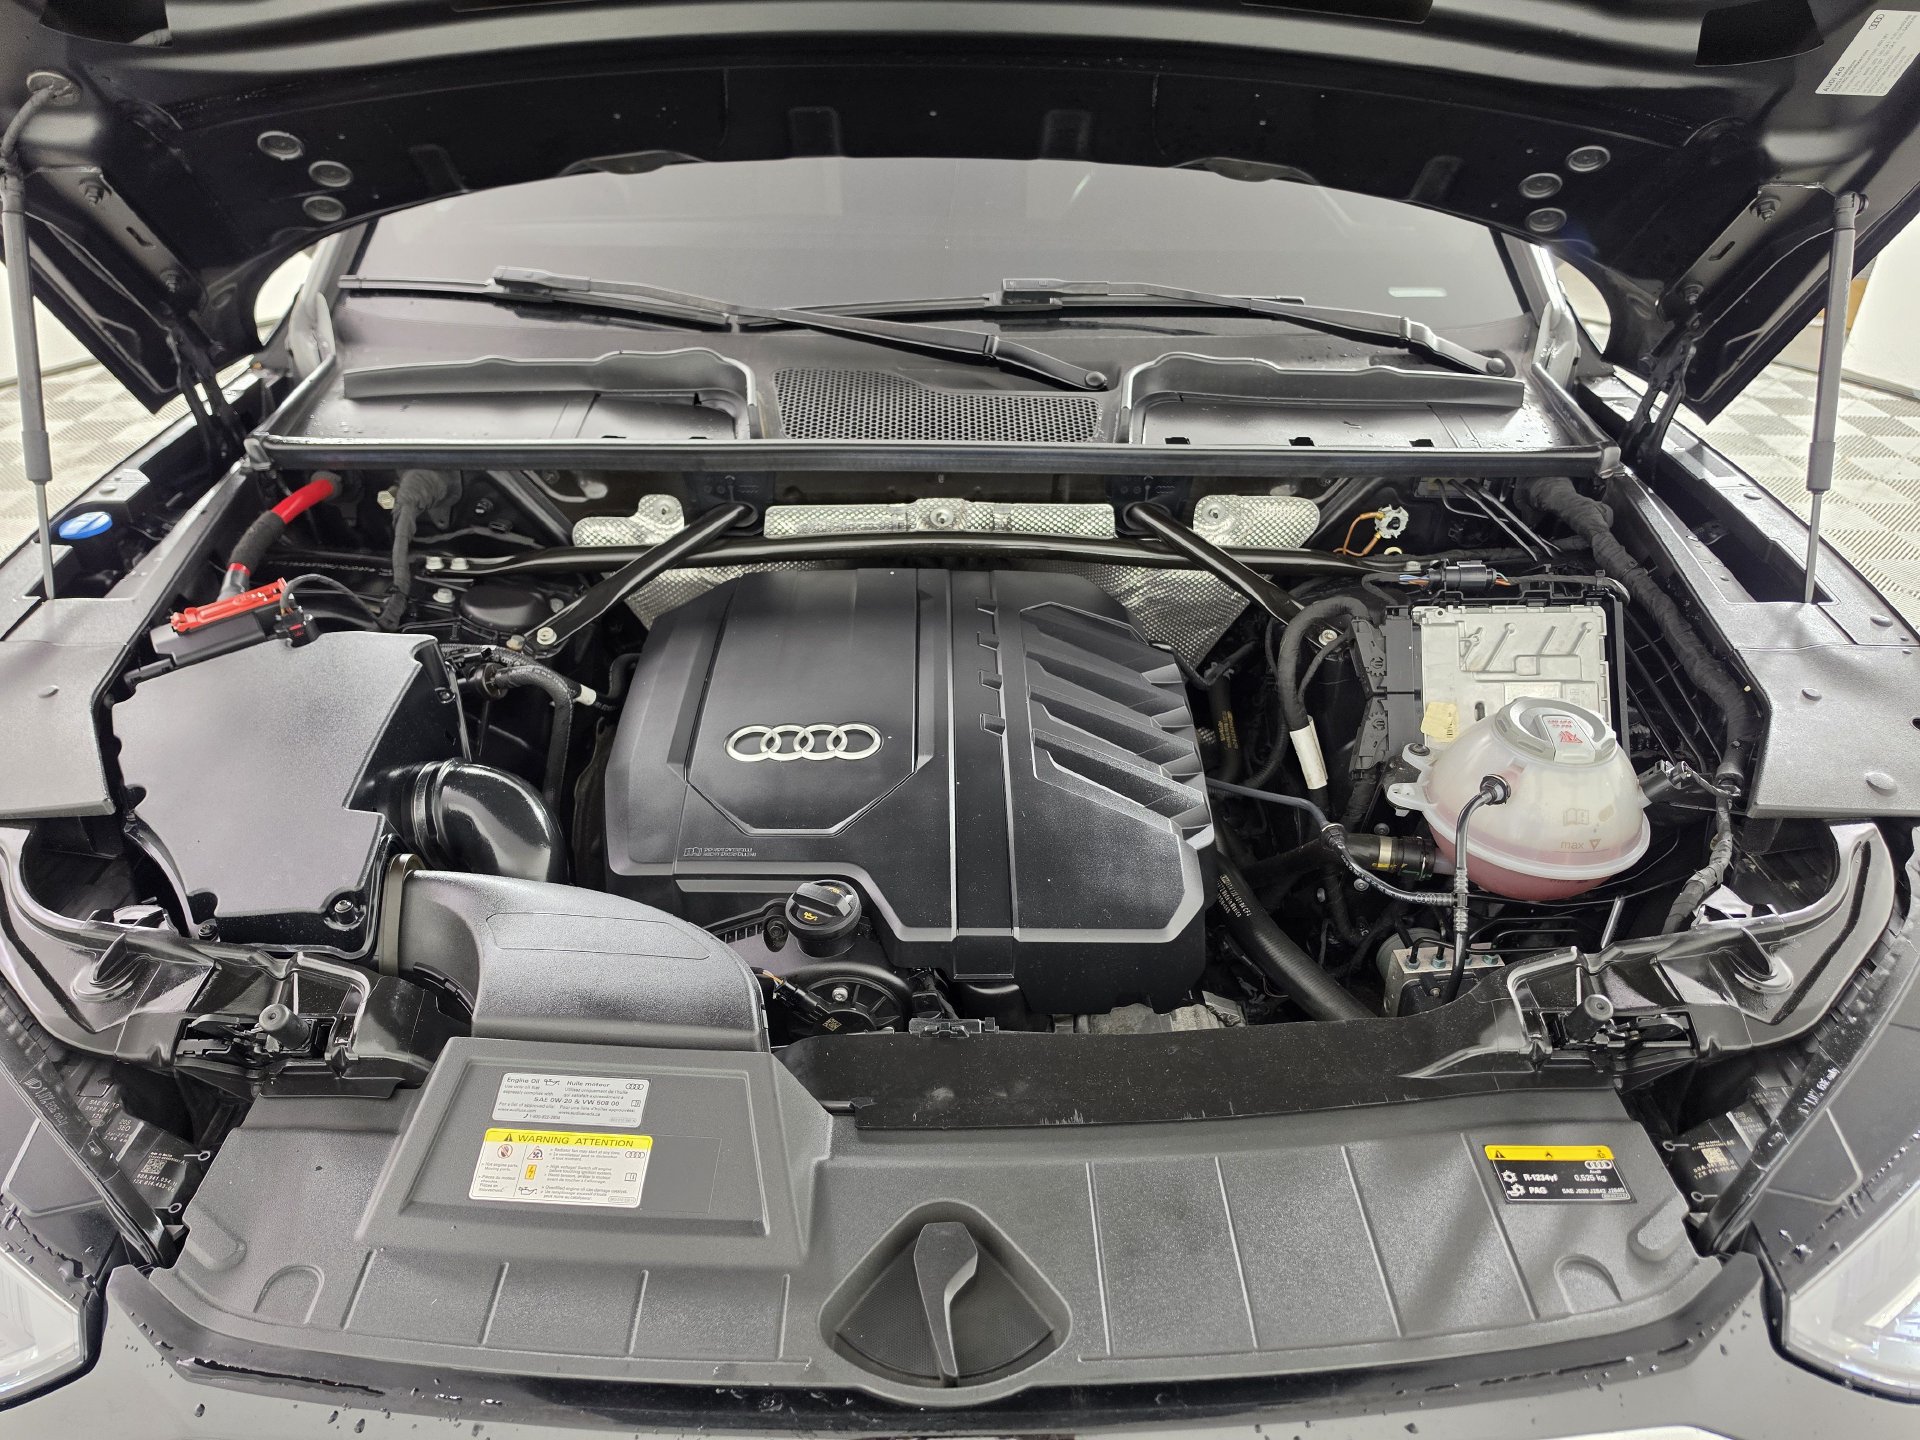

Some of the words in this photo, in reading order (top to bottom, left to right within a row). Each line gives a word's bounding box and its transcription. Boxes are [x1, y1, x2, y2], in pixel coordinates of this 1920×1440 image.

[1560, 839, 1584, 850] max
[518, 1134, 570, 1145] WARNING
[575, 1137, 634, 1148] ATTENTION
[1523, 1173, 1559, 1183] R-1234yf
[1596, 1174, 1607, 1183] kg
[1528, 1186, 1548, 1194] PAG
